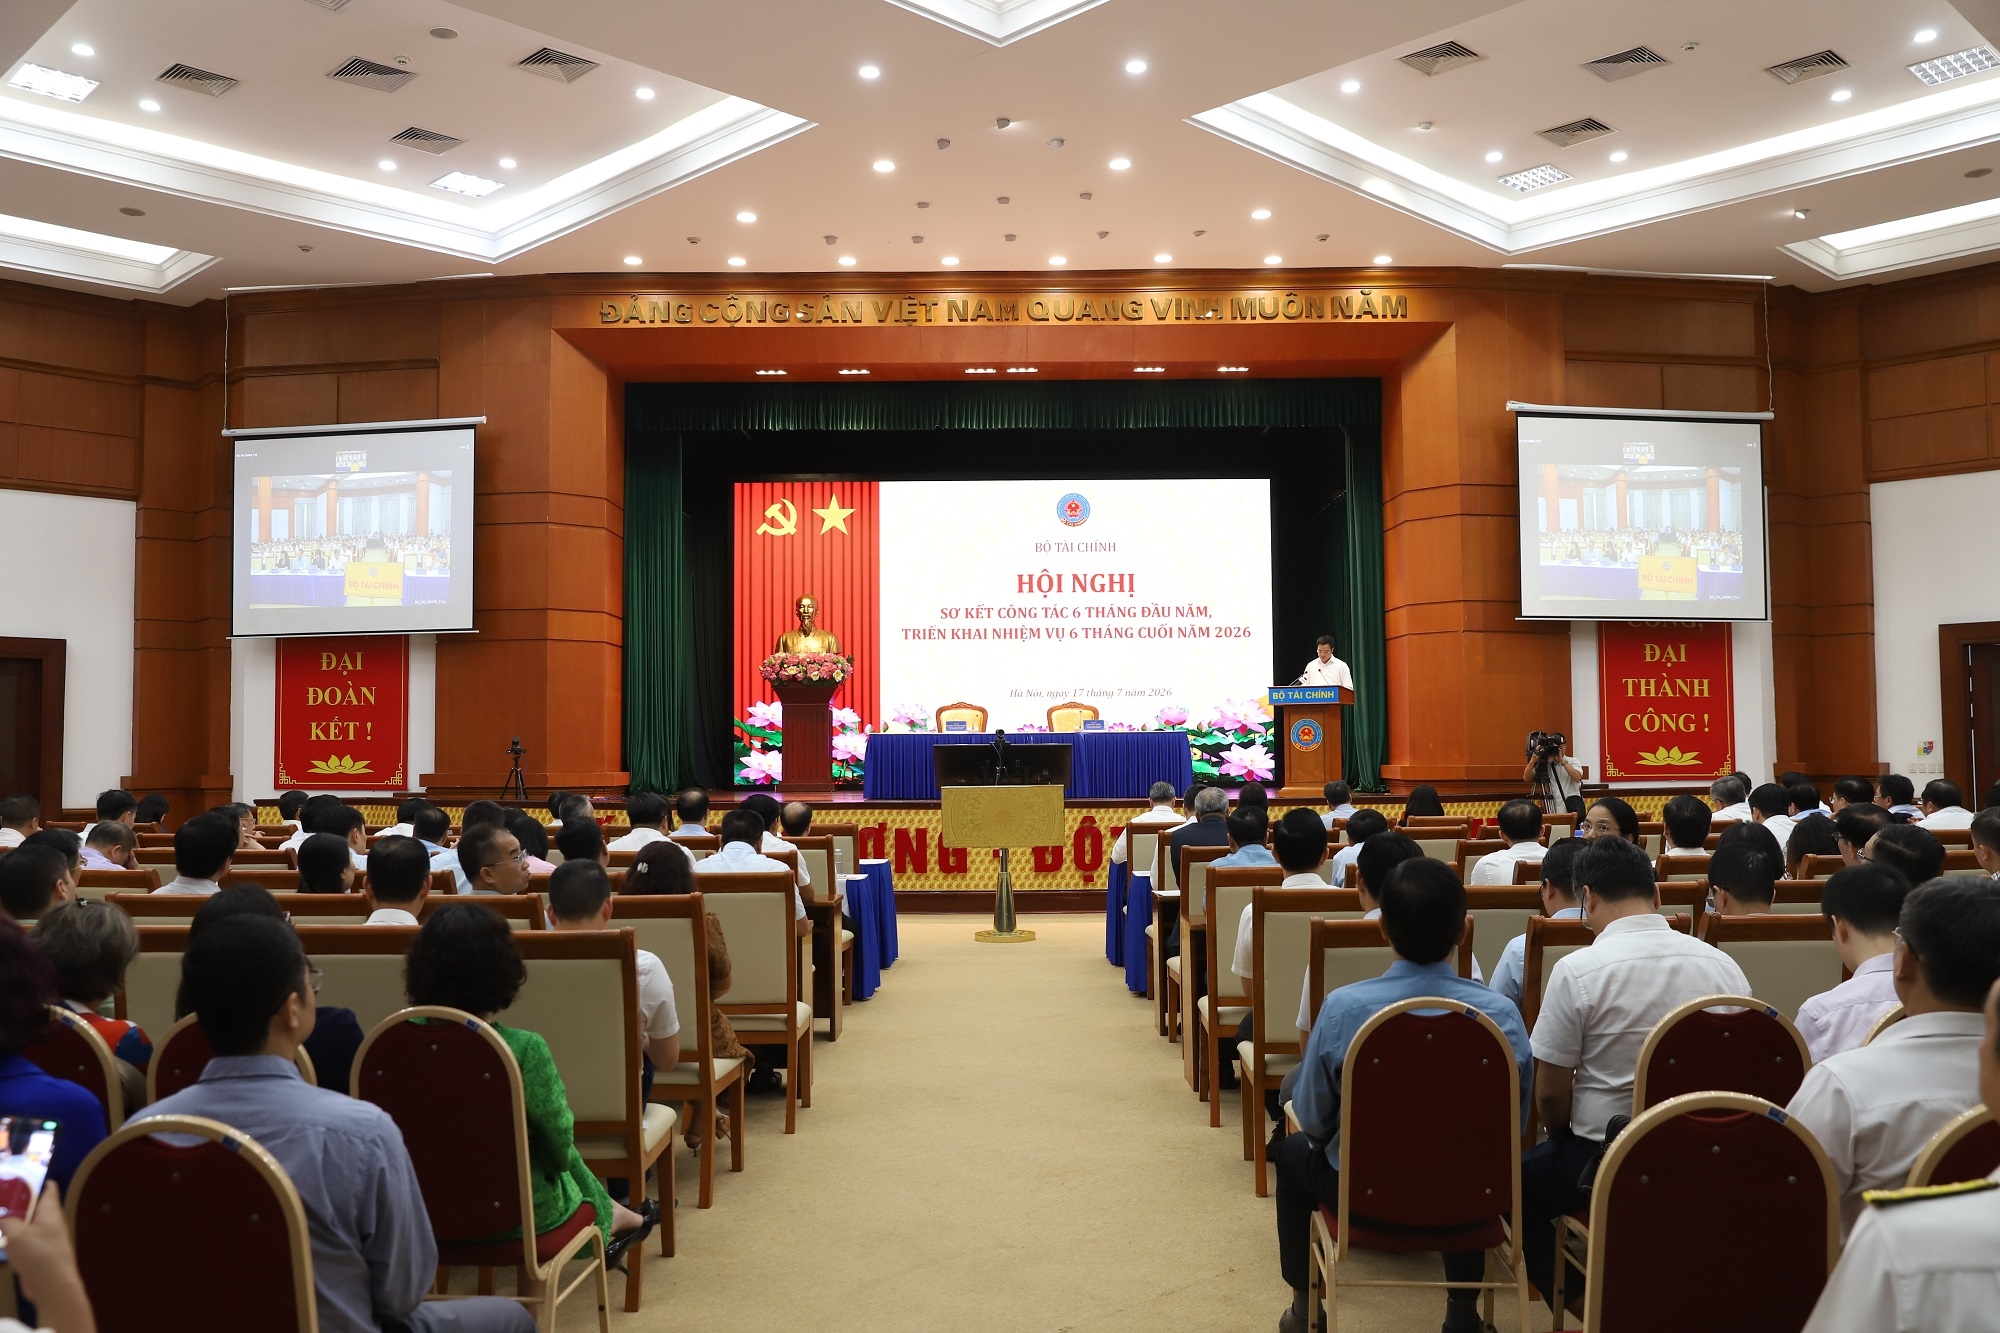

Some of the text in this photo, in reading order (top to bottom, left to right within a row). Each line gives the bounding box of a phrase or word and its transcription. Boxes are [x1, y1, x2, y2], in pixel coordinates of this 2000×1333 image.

[600, 290, 1407, 327] ĐẢNG CỘNG SẢN VIỆT NAM QUANG VINH MUÔN NĂM
[1035, 540, 1116, 554] BỘ TÀI CHÍNH
[1017, 568, 1135, 598] HỘI NGHỊ
[940, 602, 1212, 620] SƠ KẾT CÔNG TÁC 6 THÁNG ĐẦU NĂM,
[951, 628, 988, 640] KHAI
[992, 625, 1041, 642] NHIỆM
[1045, 627, 1065, 642] VỤ
[1069, 627, 1078, 639] 6
[1082, 624, 1134, 639] THÁNG
[1138, 623, 1173, 639] CUỐI
[1177, 624, 1210, 639] NĂM
[1214, 626, 1252, 639] 2026
[320, 652, 364, 676] ĐẠI
[1643, 643, 1688, 668] ĐẠI
[306, 680, 377, 706] ĐOÀN
[1009, 687, 1173, 699] Hà Nội, ngày 17 tháng 7 năm 2026
[1272, 688, 1335, 702] BỘ TÀI CHÍNH
[1622, 672, 1711, 697] THÀNH
[309, 716, 372, 741] KẾT !
[1624, 707, 1709, 733] CÔNG !
